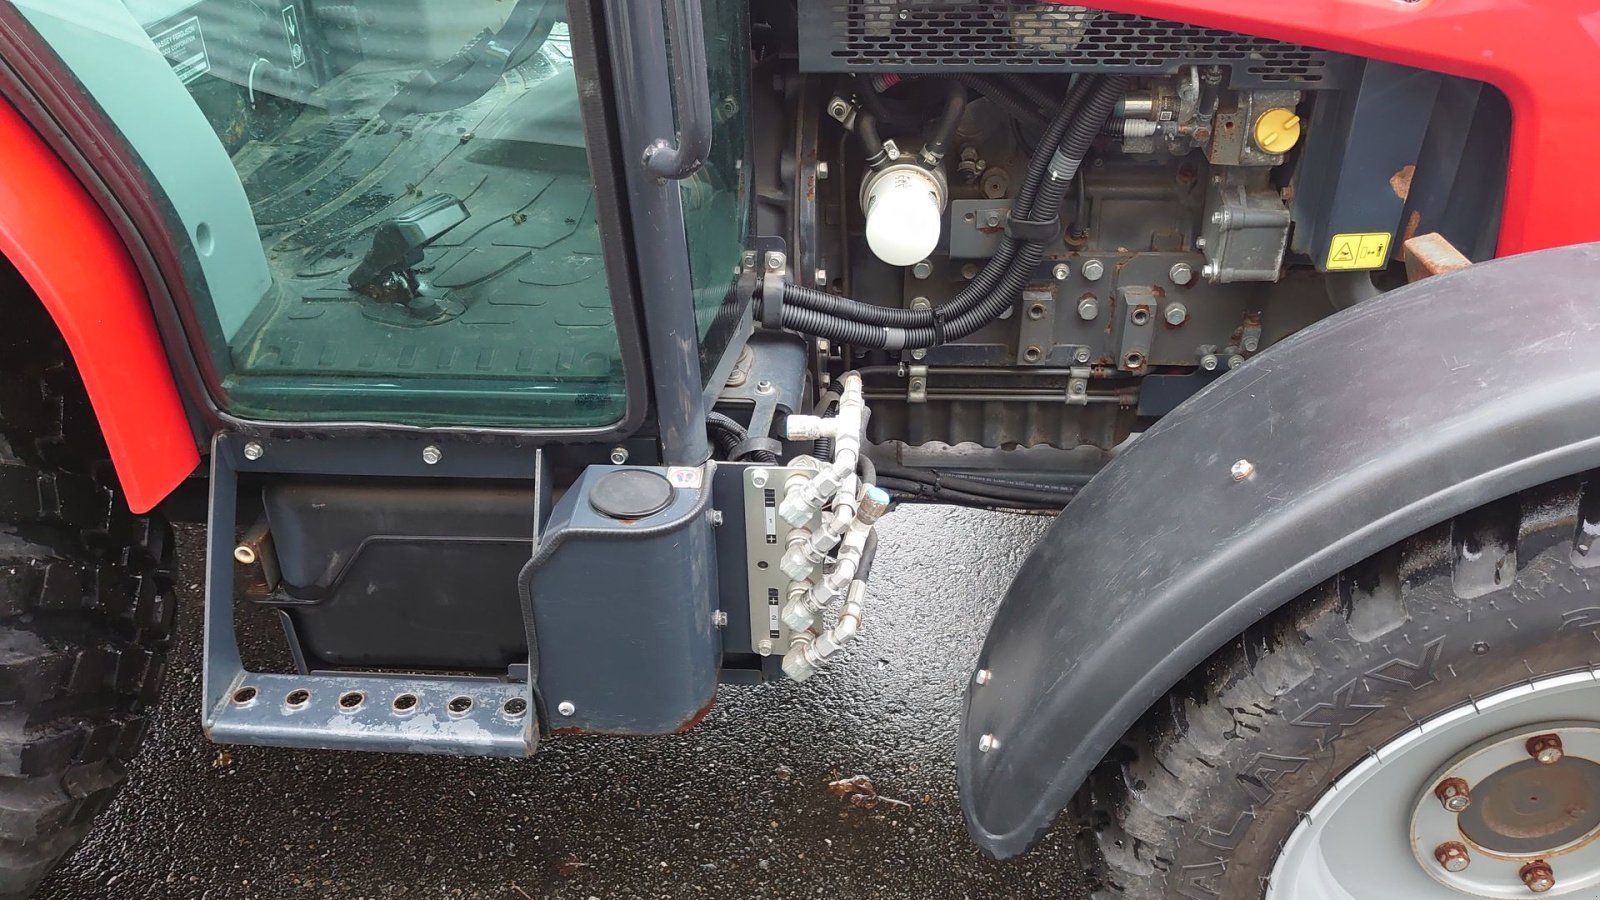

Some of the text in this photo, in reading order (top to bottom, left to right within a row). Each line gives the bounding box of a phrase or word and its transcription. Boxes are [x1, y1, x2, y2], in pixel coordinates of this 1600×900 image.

[172, 25, 196, 41] FERGUSON
[171, 35, 196, 51] CORPORATION
[1176, 634, 1448, 900] ALAXY
